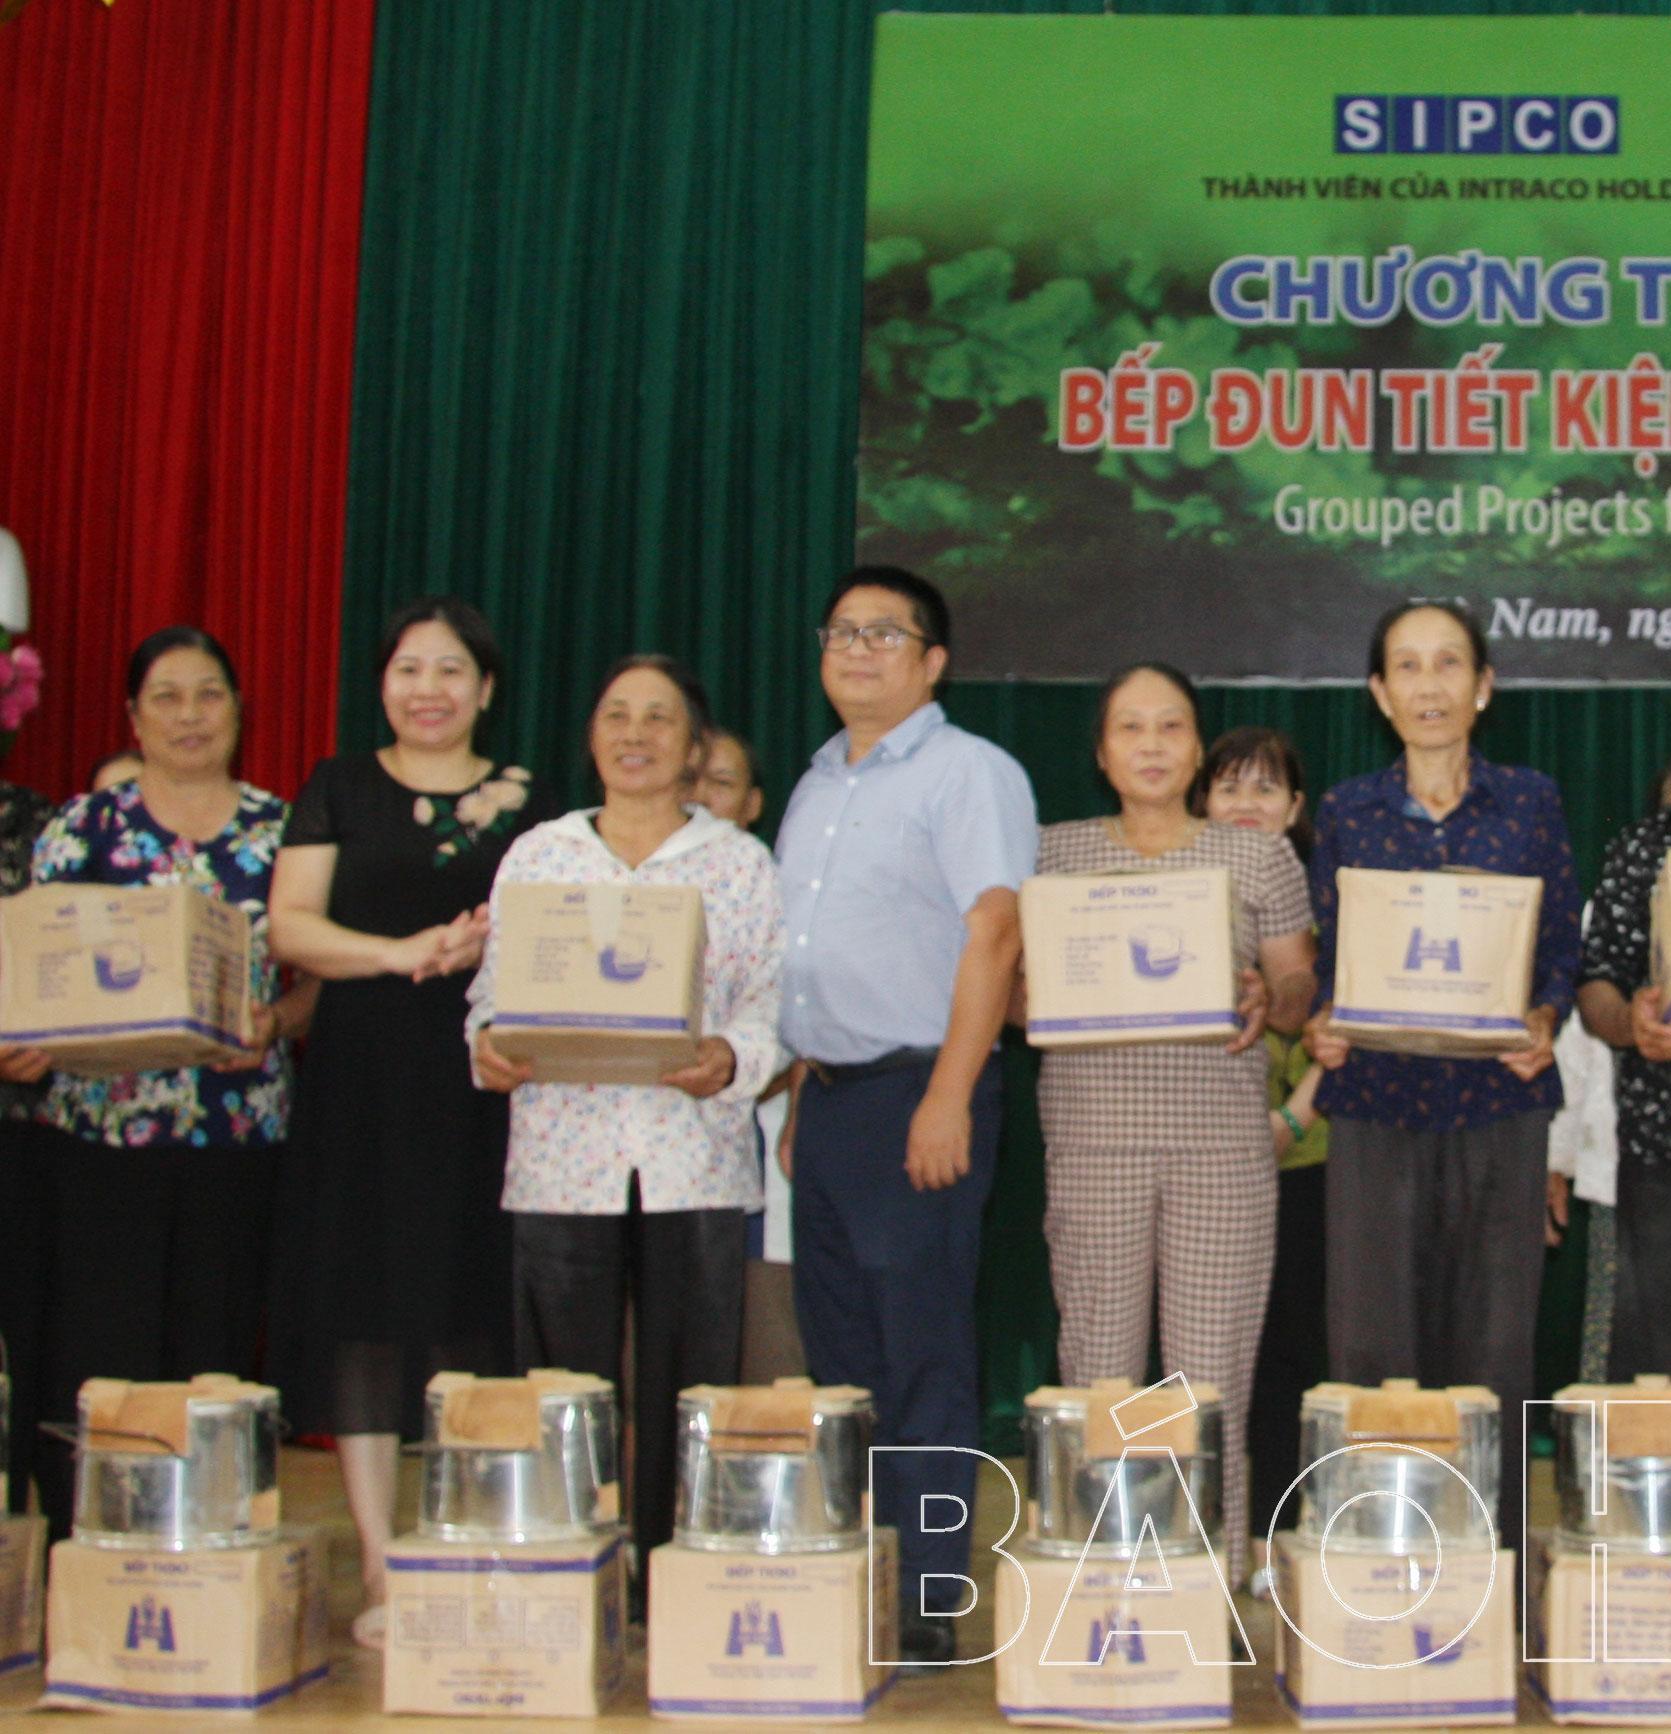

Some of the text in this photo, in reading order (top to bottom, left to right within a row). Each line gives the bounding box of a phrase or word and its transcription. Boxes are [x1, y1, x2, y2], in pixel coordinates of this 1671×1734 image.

[1341, 98, 1617, 150] SIPCO
[1203, 172, 1306, 199] THÀNH
[1313, 173, 1383, 199] VIÊN
[1390, 171, 1450, 199] CỦA
[1459, 177, 1589, 200] INTRACO
[1210, 246, 1611, 325] CHƯƠNG
[1059, 342, 1196, 452] BẾP
[1206, 368, 1374, 452] ĐUN
[1381, 343, 1539, 453] TIẾT
[1273, 483, 1463, 547] Grouped
[1477, 485, 1653, 548] Projects
[1488, 598, 1612, 646] Nam,
